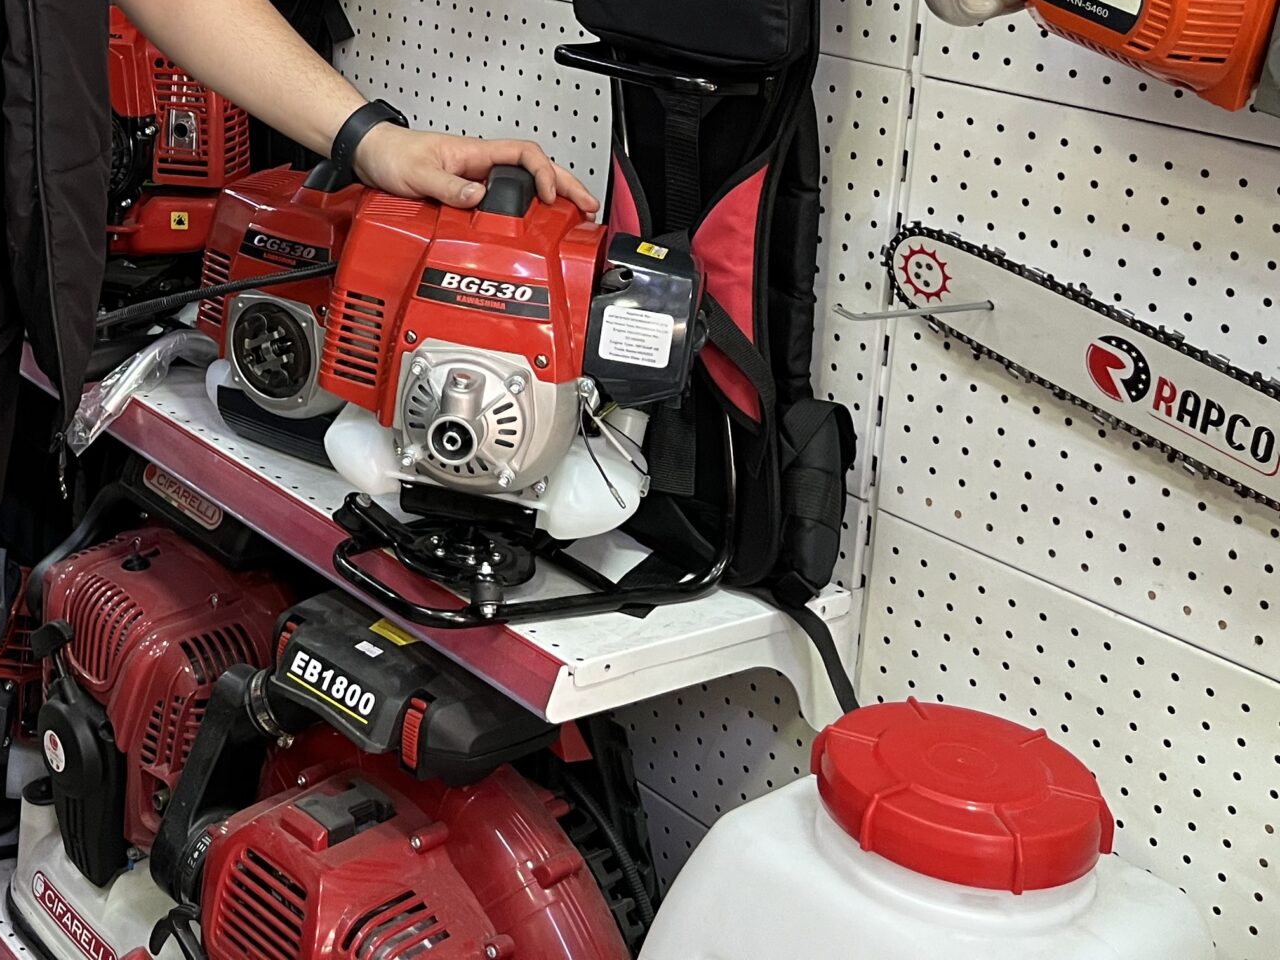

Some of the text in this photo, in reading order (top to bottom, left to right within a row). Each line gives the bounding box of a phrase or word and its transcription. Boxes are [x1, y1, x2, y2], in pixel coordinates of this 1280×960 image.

[253, 234, 316, 259] CG530
[440, 272, 533, 301] BG530
[456, 294, 507, 310] KAWASHIMA
[1152, 376, 1275, 463] RAPCO
[157, 473, 218, 521] CIFARELLI
[290, 650, 376, 716] EB1800
[44, 889, 115, 960] CIFARELL
